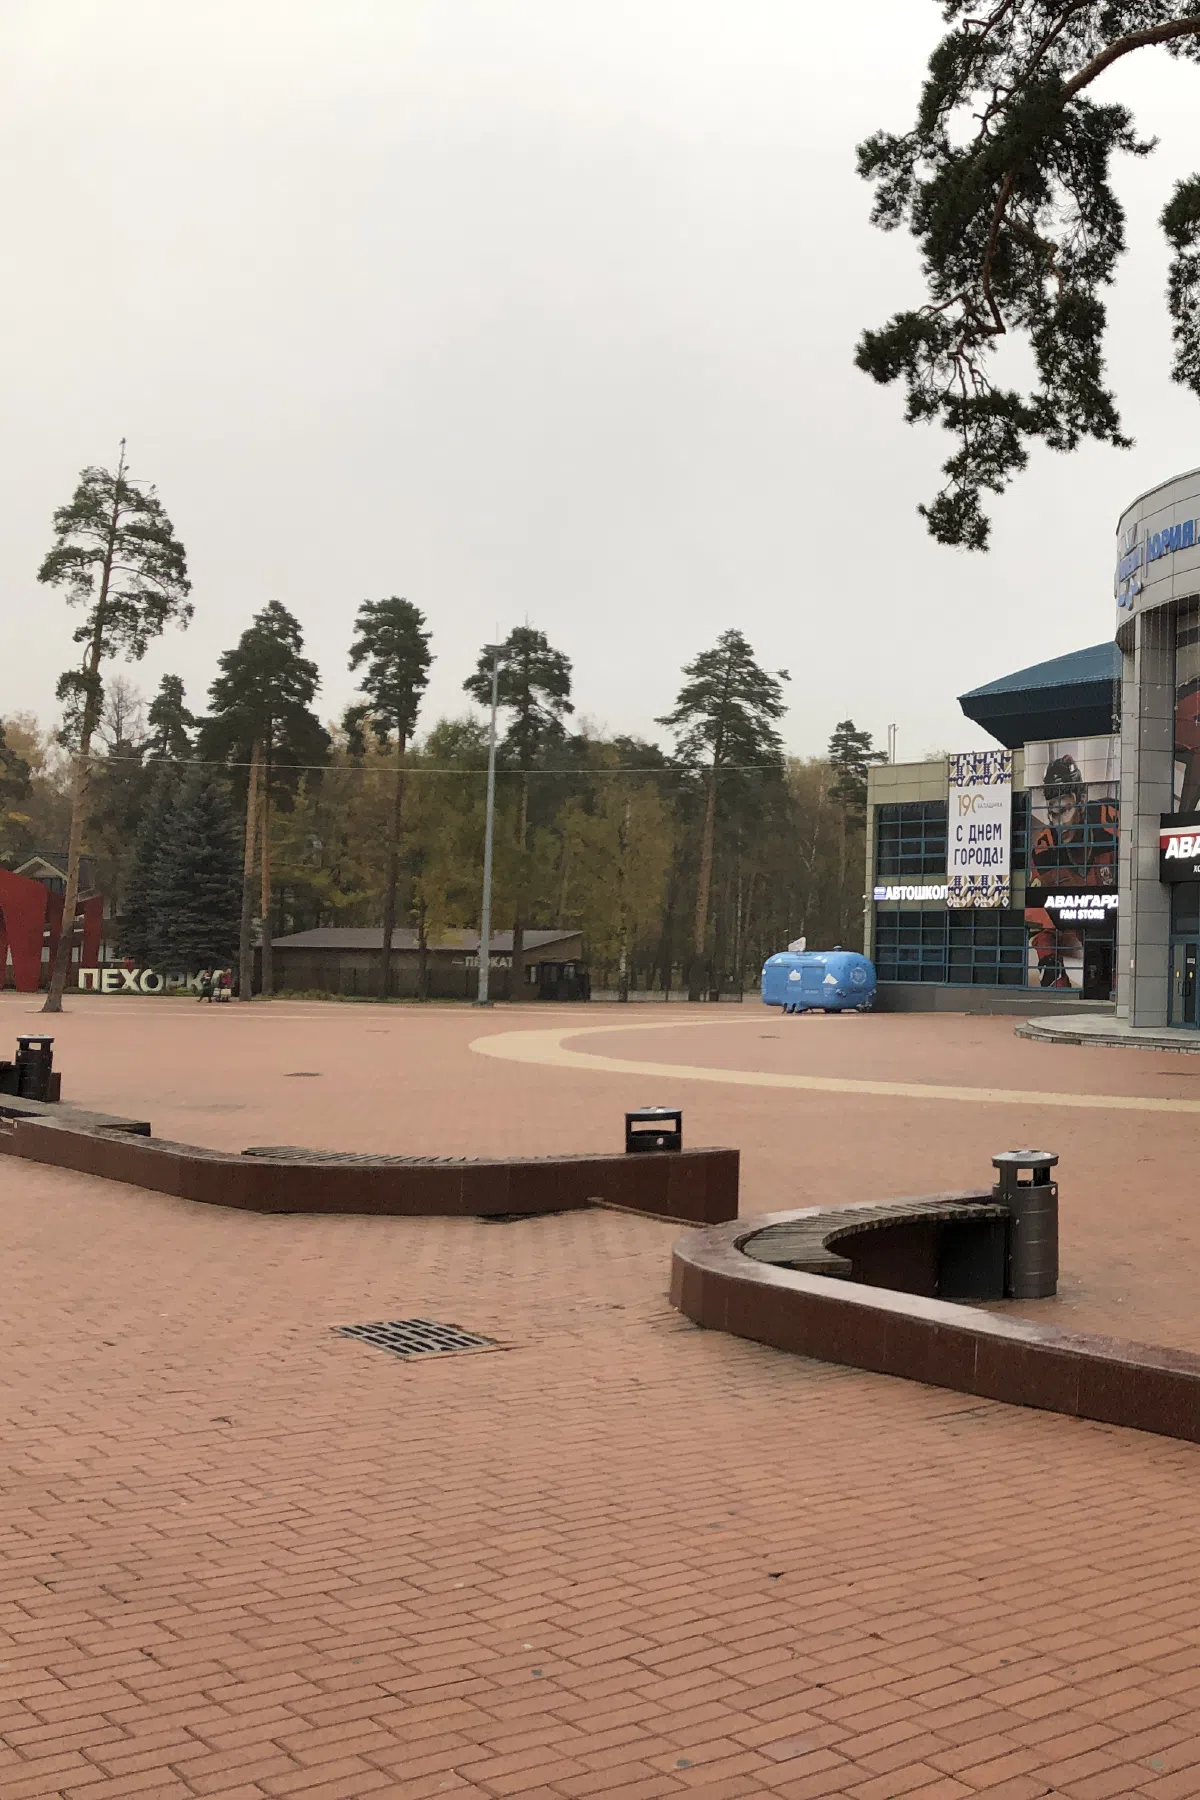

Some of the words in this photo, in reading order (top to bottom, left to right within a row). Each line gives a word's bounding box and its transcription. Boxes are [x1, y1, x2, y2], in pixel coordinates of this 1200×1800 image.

[1147, 519, 1194, 563] ЮРИЯ
[1044, 894, 1119, 909] АВАНГАРД
[1060, 909, 1077, 919] FAN
[1078, 909, 1105, 919] STORE
